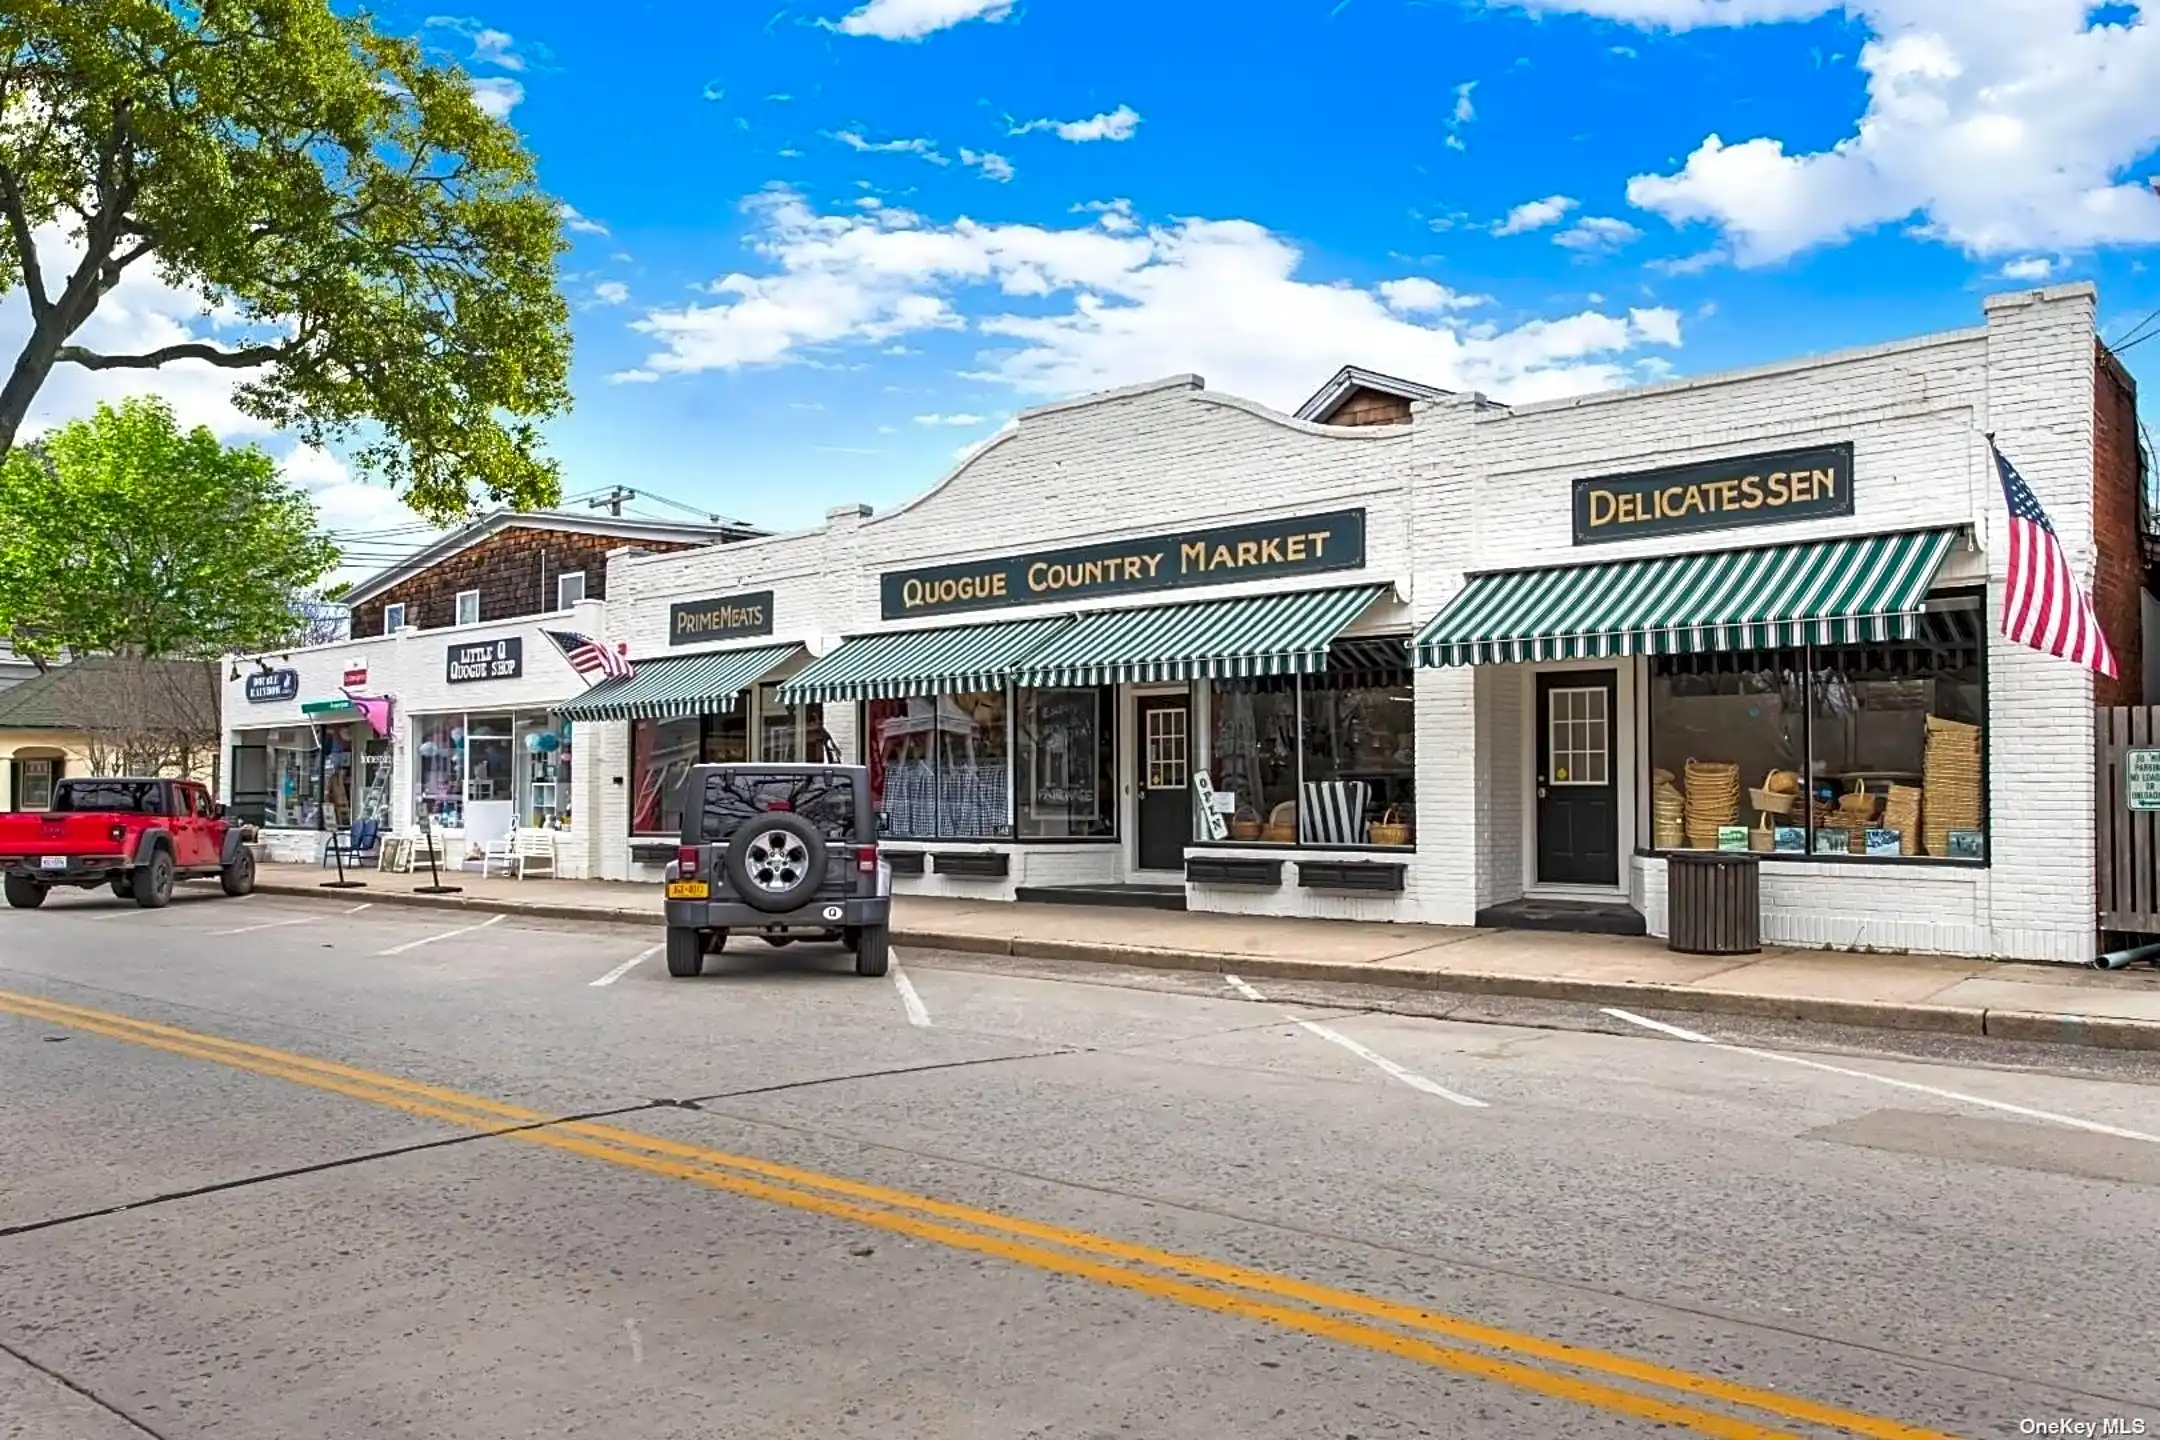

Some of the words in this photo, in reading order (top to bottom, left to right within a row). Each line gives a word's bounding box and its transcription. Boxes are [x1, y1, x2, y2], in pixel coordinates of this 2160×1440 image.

[1589, 468, 1835, 527] DELICATESSEN
[903, 573, 1007, 608] QUOGUE
[1027, 553, 1164, 592] COUNTRY
[1180, 531, 1330, 574] MARKET
[451, 661, 487, 679] QUOGUE
[492, 660, 515, 676] SHOP
[461, 646, 493, 663] LITTLE
[497, 641, 507, 660] Q
